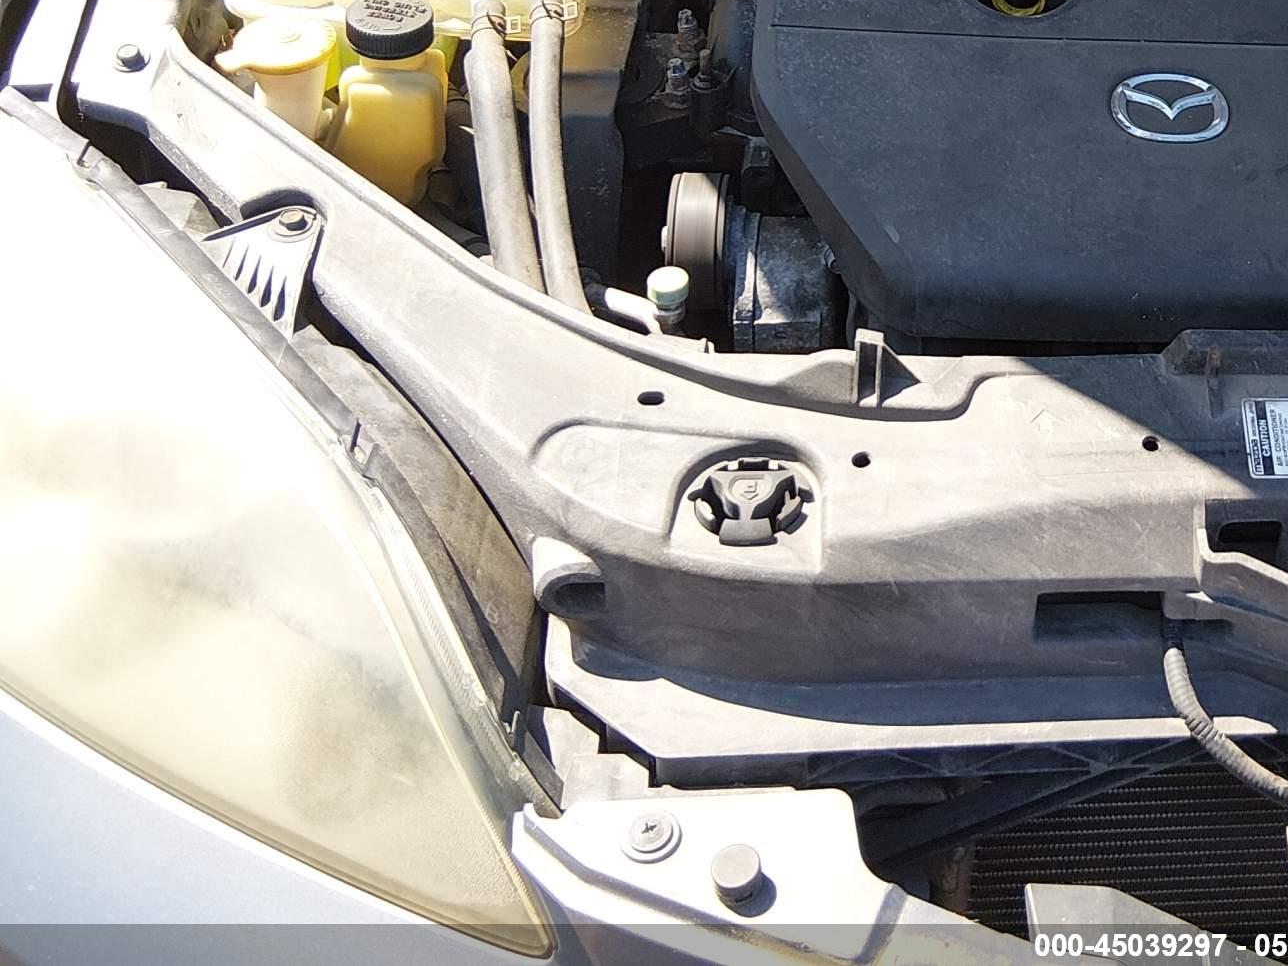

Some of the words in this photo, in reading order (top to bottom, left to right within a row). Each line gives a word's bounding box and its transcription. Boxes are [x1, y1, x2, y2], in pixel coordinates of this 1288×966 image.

[1258, 419, 1271, 458] CAUTION
[1269, 409, 1282, 453] CONDITIONER
[1251, 438, 1264, 473] mazda
